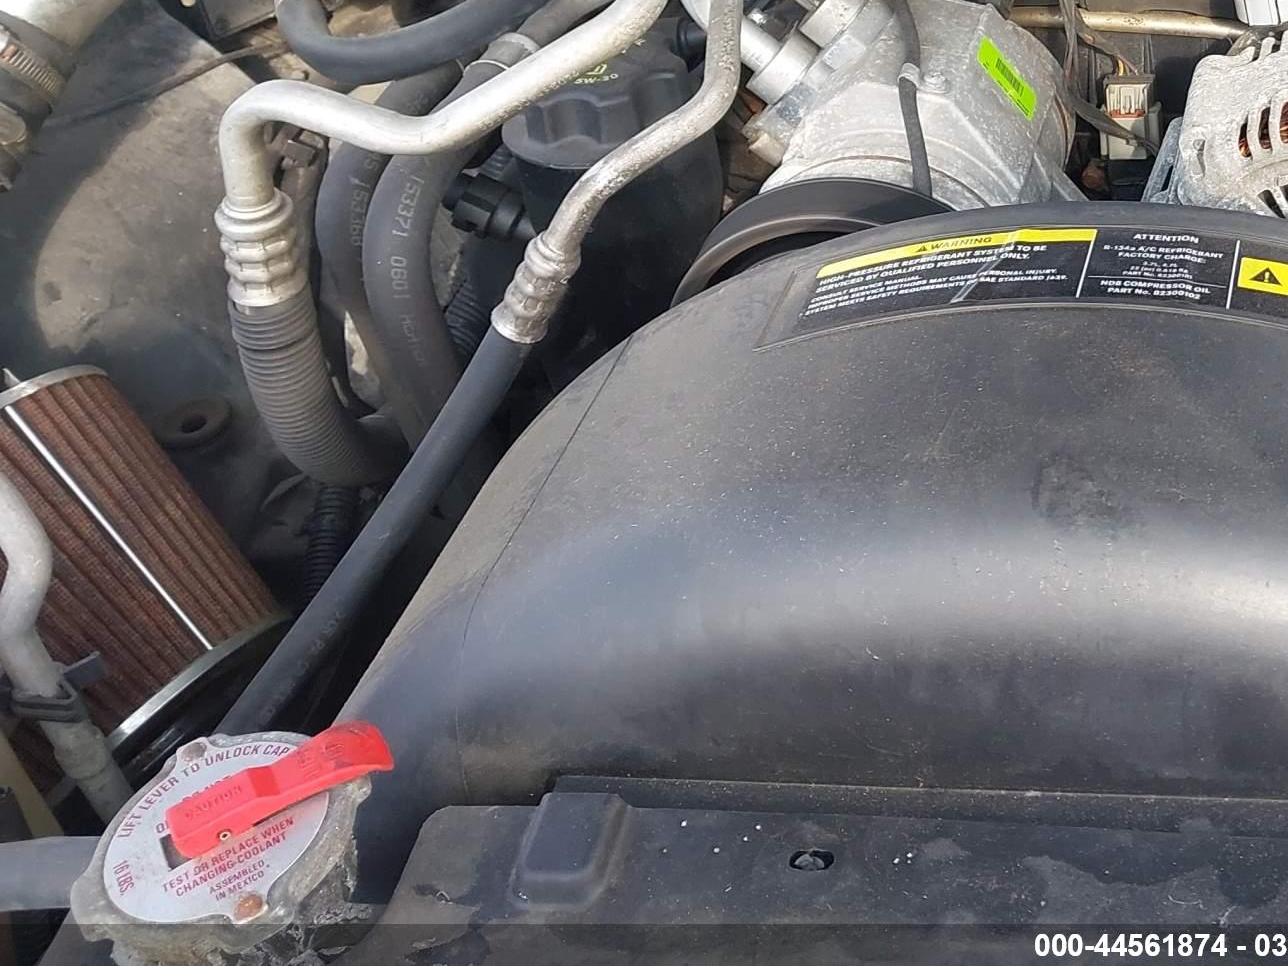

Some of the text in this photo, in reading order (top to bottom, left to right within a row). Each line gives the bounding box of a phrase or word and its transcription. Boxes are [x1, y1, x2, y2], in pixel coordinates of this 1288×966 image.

[930, 237, 992, 250] WARNING
[1133, 233, 1199, 243] ATTENTION
[1118, 252, 1162, 260] FACTORY
[1158, 247, 1224, 259] REFRIGERANT
[815, 277, 863, 293] SERVICED
[866, 273, 880, 281] BY
[880, 263, 935, 278] QUALIFIED
[936, 256, 998, 268] PERSONNEL
[819, 261, 899, 285] HIGH-PRESSURE
[901, 251, 971, 266] REFRIGERANT
[973, 245, 1014, 254] SYSTEM
[849, 281, 883, 294] SERVICE
[849, 287, 885, 299] SERVICE
[929, 276, 949, 284] MAY
[866, 291, 897, 301] SAFETY
[898, 281, 967, 294] REQUIREMENTS
[1123, 280, 1192, 291] COMPRESSOR
[117, 814, 142, 838] LIFT
[139, 776, 180, 810] LEVER
[181, 763, 200, 777] TO
[204, 744, 263, 766] UNLOCK
[262, 744, 290, 756] CAP
[163, 817, 295, 893] TEST OR REPLACE WHEN
[176, 833, 287, 897] CHANGING COOLANT
[113, 860, 129, 875] 16
[209, 859, 265, 895] ASSEMBLED
[215, 871, 265, 901] IN MEXICO
